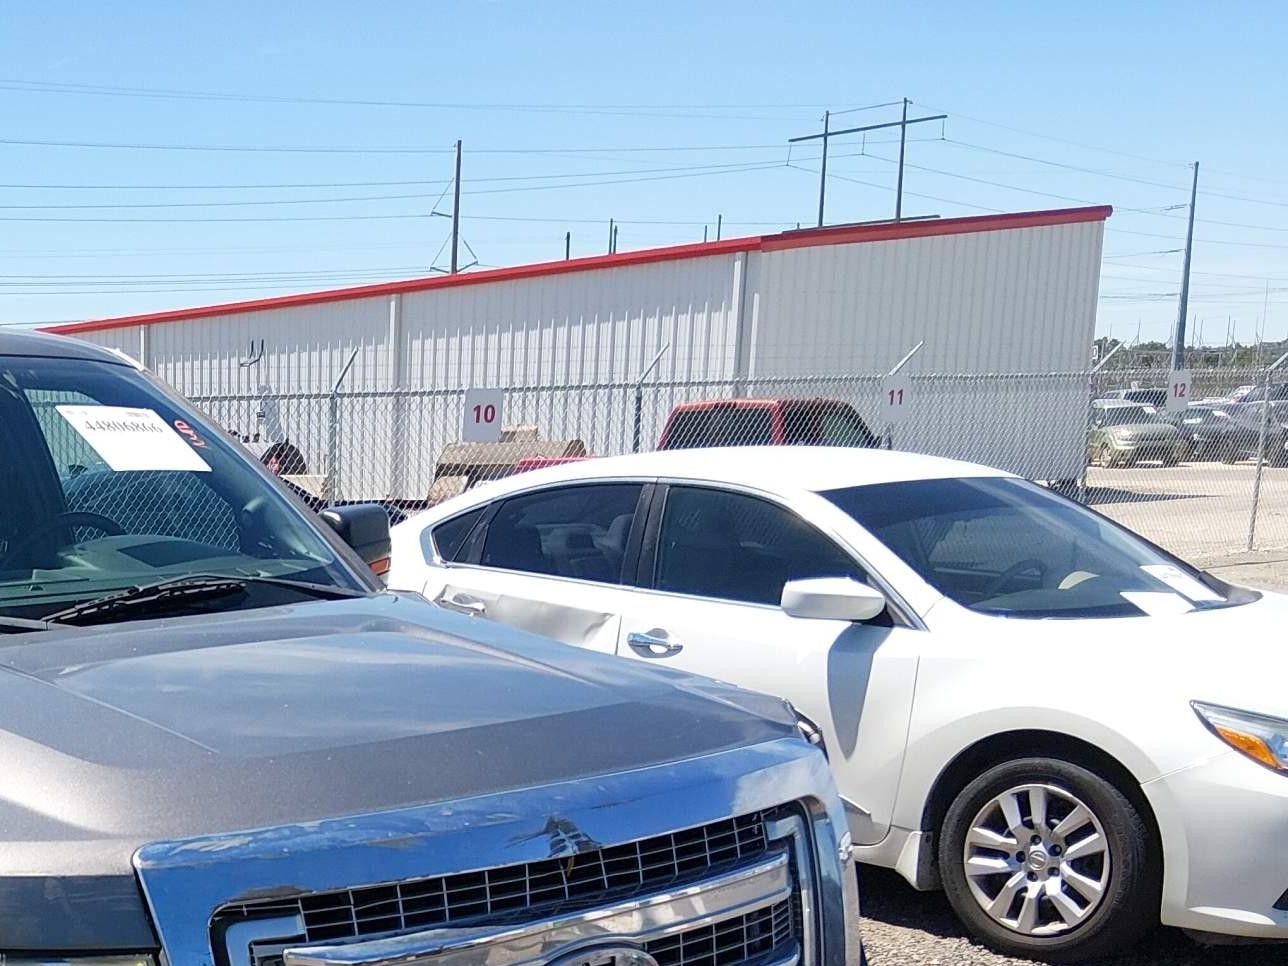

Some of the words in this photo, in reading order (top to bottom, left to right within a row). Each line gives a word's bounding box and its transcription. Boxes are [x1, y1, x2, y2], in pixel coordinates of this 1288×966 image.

[888, 389, 903, 406] 11
[1173, 382, 1186, 398] 12
[473, 404, 496, 424] 10
[84, 420, 163, 433] 44806866
